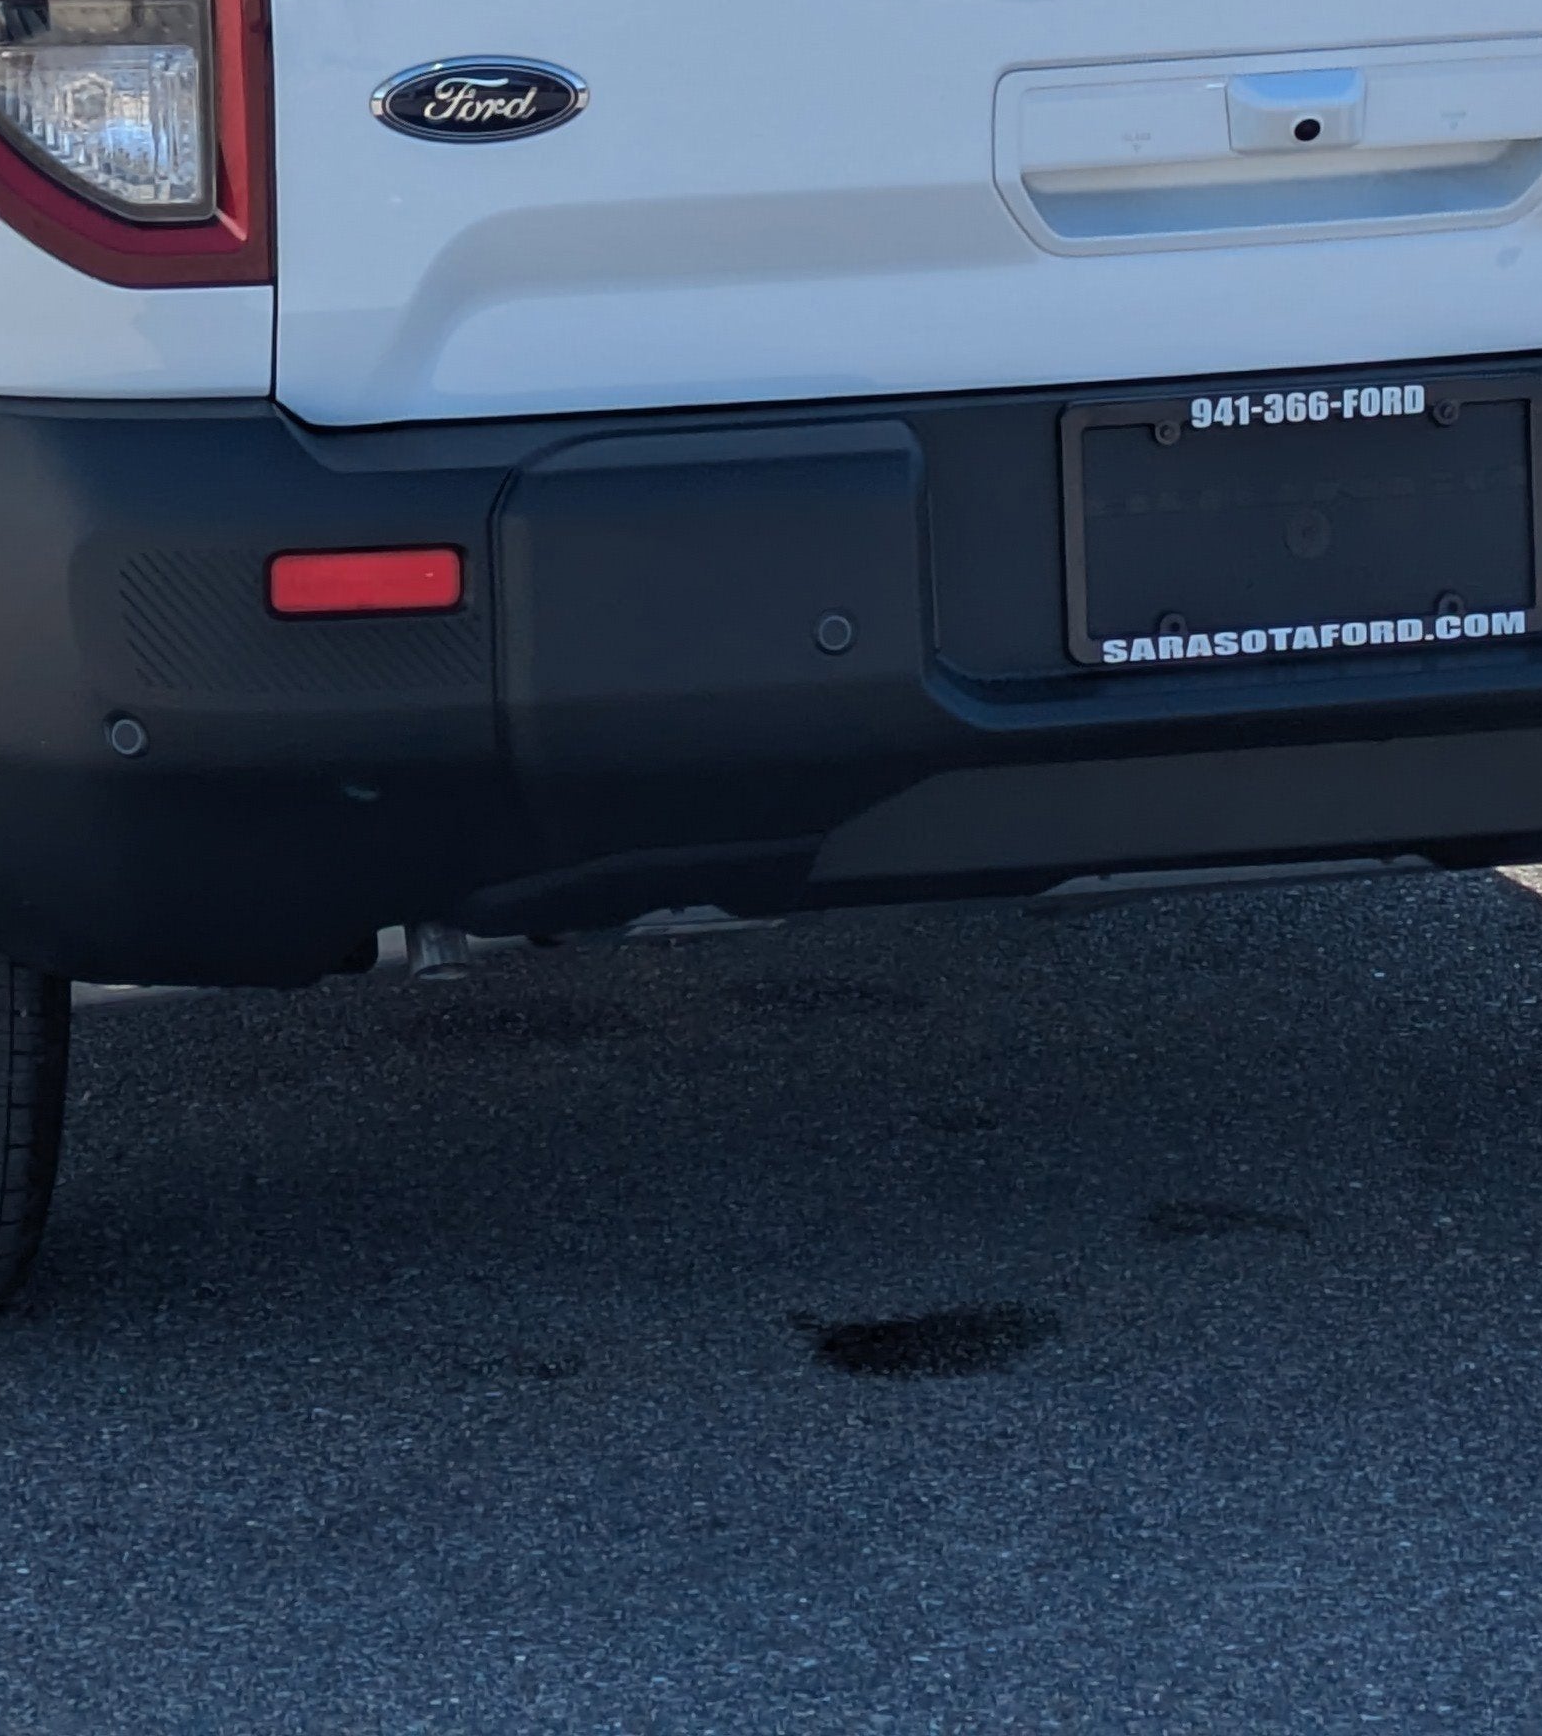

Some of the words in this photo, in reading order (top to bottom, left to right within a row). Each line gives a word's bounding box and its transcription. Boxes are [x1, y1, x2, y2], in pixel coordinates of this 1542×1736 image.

[424, 77, 537, 121] Ford
[1191, 385, 1425, 428] 941-366-FORD
[1103, 610, 1526, 664] SARASOTAFORD.COM
